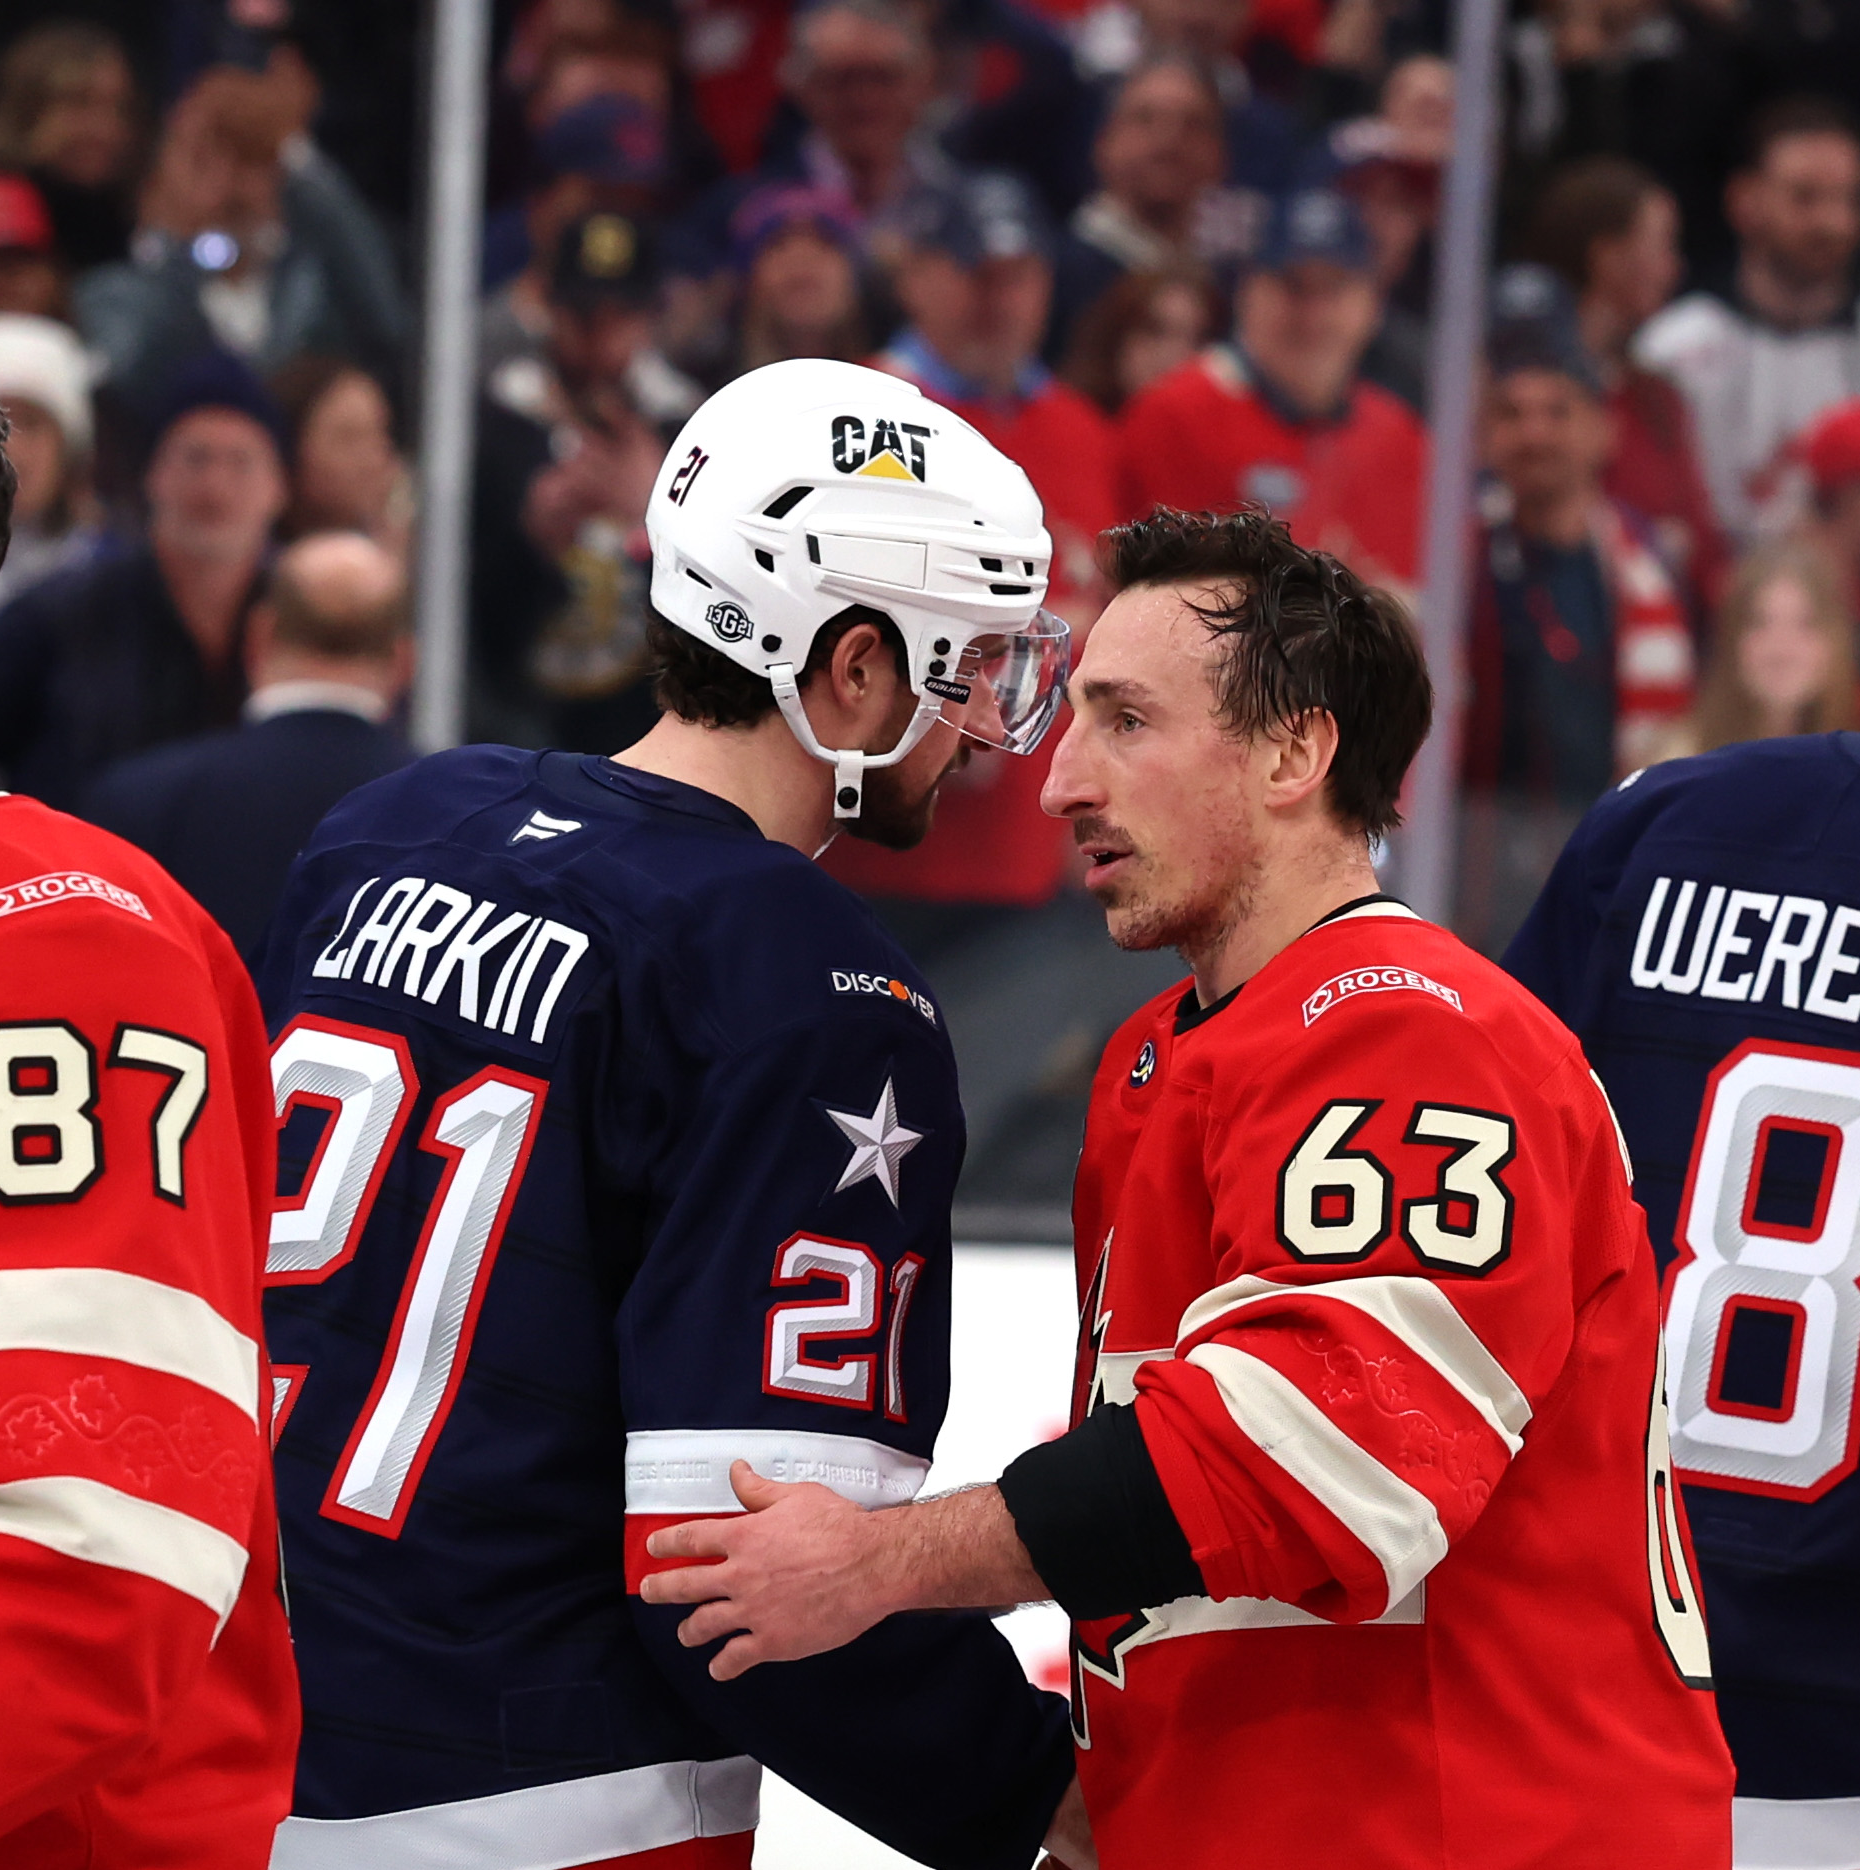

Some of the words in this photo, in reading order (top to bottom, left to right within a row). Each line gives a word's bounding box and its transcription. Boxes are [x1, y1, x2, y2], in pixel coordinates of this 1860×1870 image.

[667, 445, 710, 507] 21
[831, 415, 932, 482] CAT
[926, 680, 969, 698] BAUER
[18, 876, 141, 912] ROGERS
[312, 876, 589, 1046] LARKIN
[1338, 970, 1457, 1004] ROGERS
[831, 971, 937, 1025] DISCOVER
[1275, 1097, 1517, 1278] 63
[262, 1012, 550, 1541] 21
[761, 1230, 926, 1425] 21
